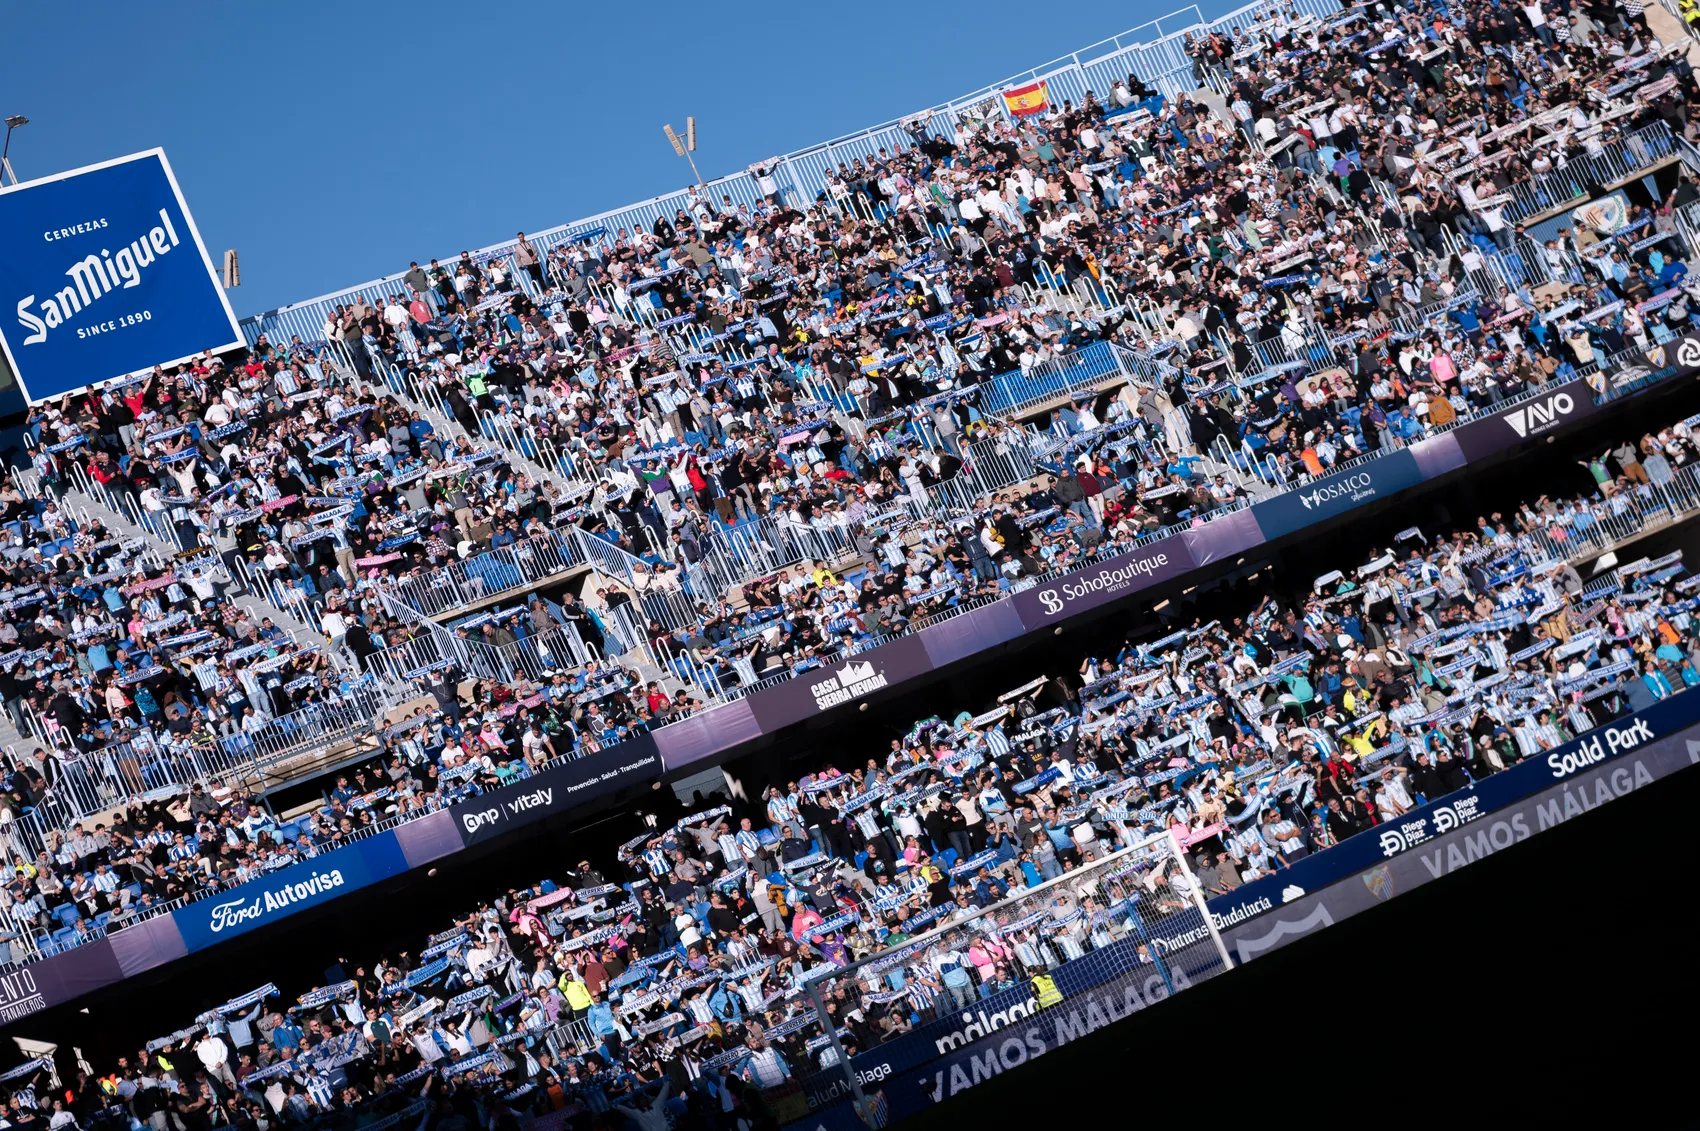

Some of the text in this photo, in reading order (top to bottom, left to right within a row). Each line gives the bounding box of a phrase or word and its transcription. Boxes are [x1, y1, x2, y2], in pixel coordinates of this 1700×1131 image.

[44, 218, 108, 242] CERVEZAS
[77, 310, 152, 339] SINCE 1890
[465, 451, 486, 462] MALAGA
[709, 443, 738, 462] MALAGA
[562, 486, 590, 499] INVENCIBLES
[318, 510, 341, 520] MALAGA
[296, 532, 319, 543] MALAGA
[1107, 580, 1131, 593] HOTELS
[257, 656, 289, 669] INVENCIBLES
[124, 670, 151, 683] A-HERRERO
[1126, 671, 1158, 685] INVENCIBLES
[811, 677, 840, 698] CASH
[815, 673, 888, 711] SIERRA NEVADA
[1179, 695, 1208, 710] MALAGA
[975, 709, 1006, 725] INVENCIBLES
[1015, 729, 1046, 741] MALAGA
[1548, 718, 1655, 778] Sould Park
[567, 755, 655, 793] Prevención Salud Tranquilidad
[1147, 766, 1182, 782] MALAGA
[1277, 777, 1298, 788] MALAGA
[508, 788, 552, 815] vitaly
[846, 797, 868, 810] MALAGA
[1453, 796, 1478, 810] Diego
[1420, 760, 1654, 878] VAMOS MÁLAGA
[1457, 806, 1478, 819] Díaz
[1190, 825, 1217, 841] MALAGA
[1401, 819, 1426, 834] Diego
[1405, 829, 1426, 842] Díaz
[210, 869, 344, 932] Ford Autovisa
[912, 912, 931, 924] MALAGA
[593, 925, 622, 941] MALAGA
[814, 920, 846, 933] MALAGA
[637, 950, 676, 967] MALAGA
[728, 961, 763, 979] MALAGA
[314, 986, 342, 999] A-HERRERO
[452, 988, 487, 1004] MALAGA
[2, 996, 46, 1022] PANADEROS
[622, 995, 658, 1013] INVENCIBLES
[776, 1018, 806, 1034] A-HERRERO
[919, 965, 1193, 1103] VAMOS MÁLAGA
[456, 1055, 486, 1071] MALAGA
[707, 1051, 738, 1067] A-HERRERO
[808, 1082, 841, 1109] alud
